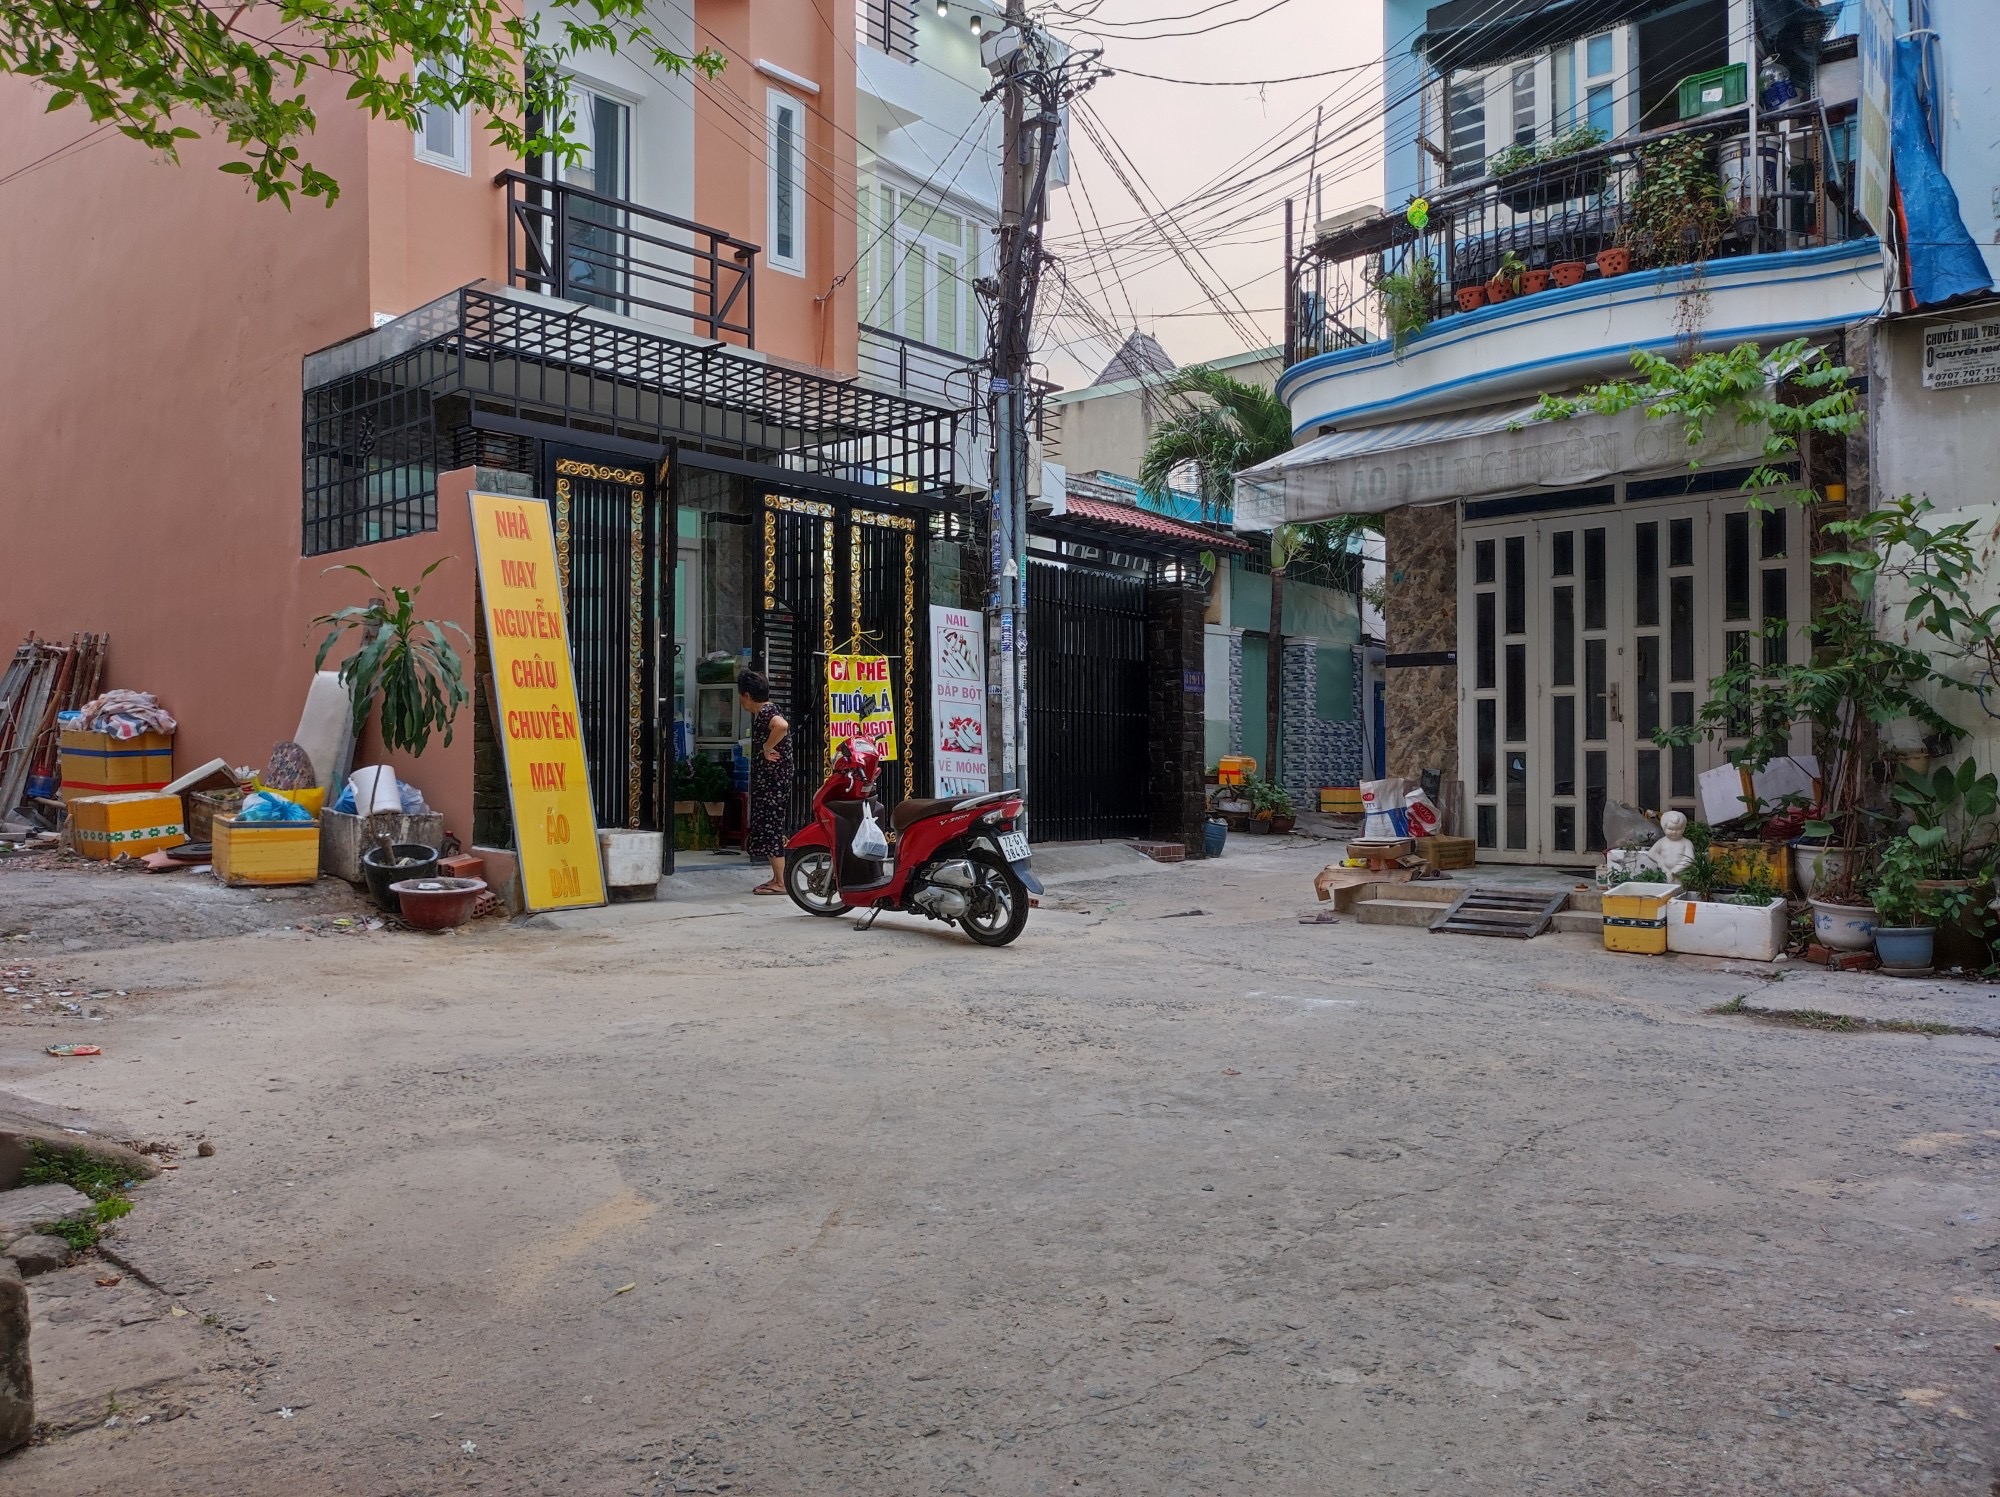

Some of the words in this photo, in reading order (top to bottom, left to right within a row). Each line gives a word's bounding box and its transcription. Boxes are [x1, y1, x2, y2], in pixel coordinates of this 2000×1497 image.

[1962, 324, 1978, 341] NHÀ
[495, 505, 531, 541] NHÀ
[501, 560, 537, 589] MAY
[493, 598, 562, 639] NGUYỄN
[946, 613, 969, 628] NAIL
[511, 653, 558, 689] CHÂU
[831, 657, 850, 681] CÀ
[857, 657, 888, 681] PHÊ
[962, 685, 982, 702] BỘT
[508, 704, 577, 740] CHUYÊN
[530, 762, 567, 792] MAY
[956, 759, 986, 775] MÓNG
[546, 807, 570, 845] ÁO
[548, 859, 581, 899] DÀI
